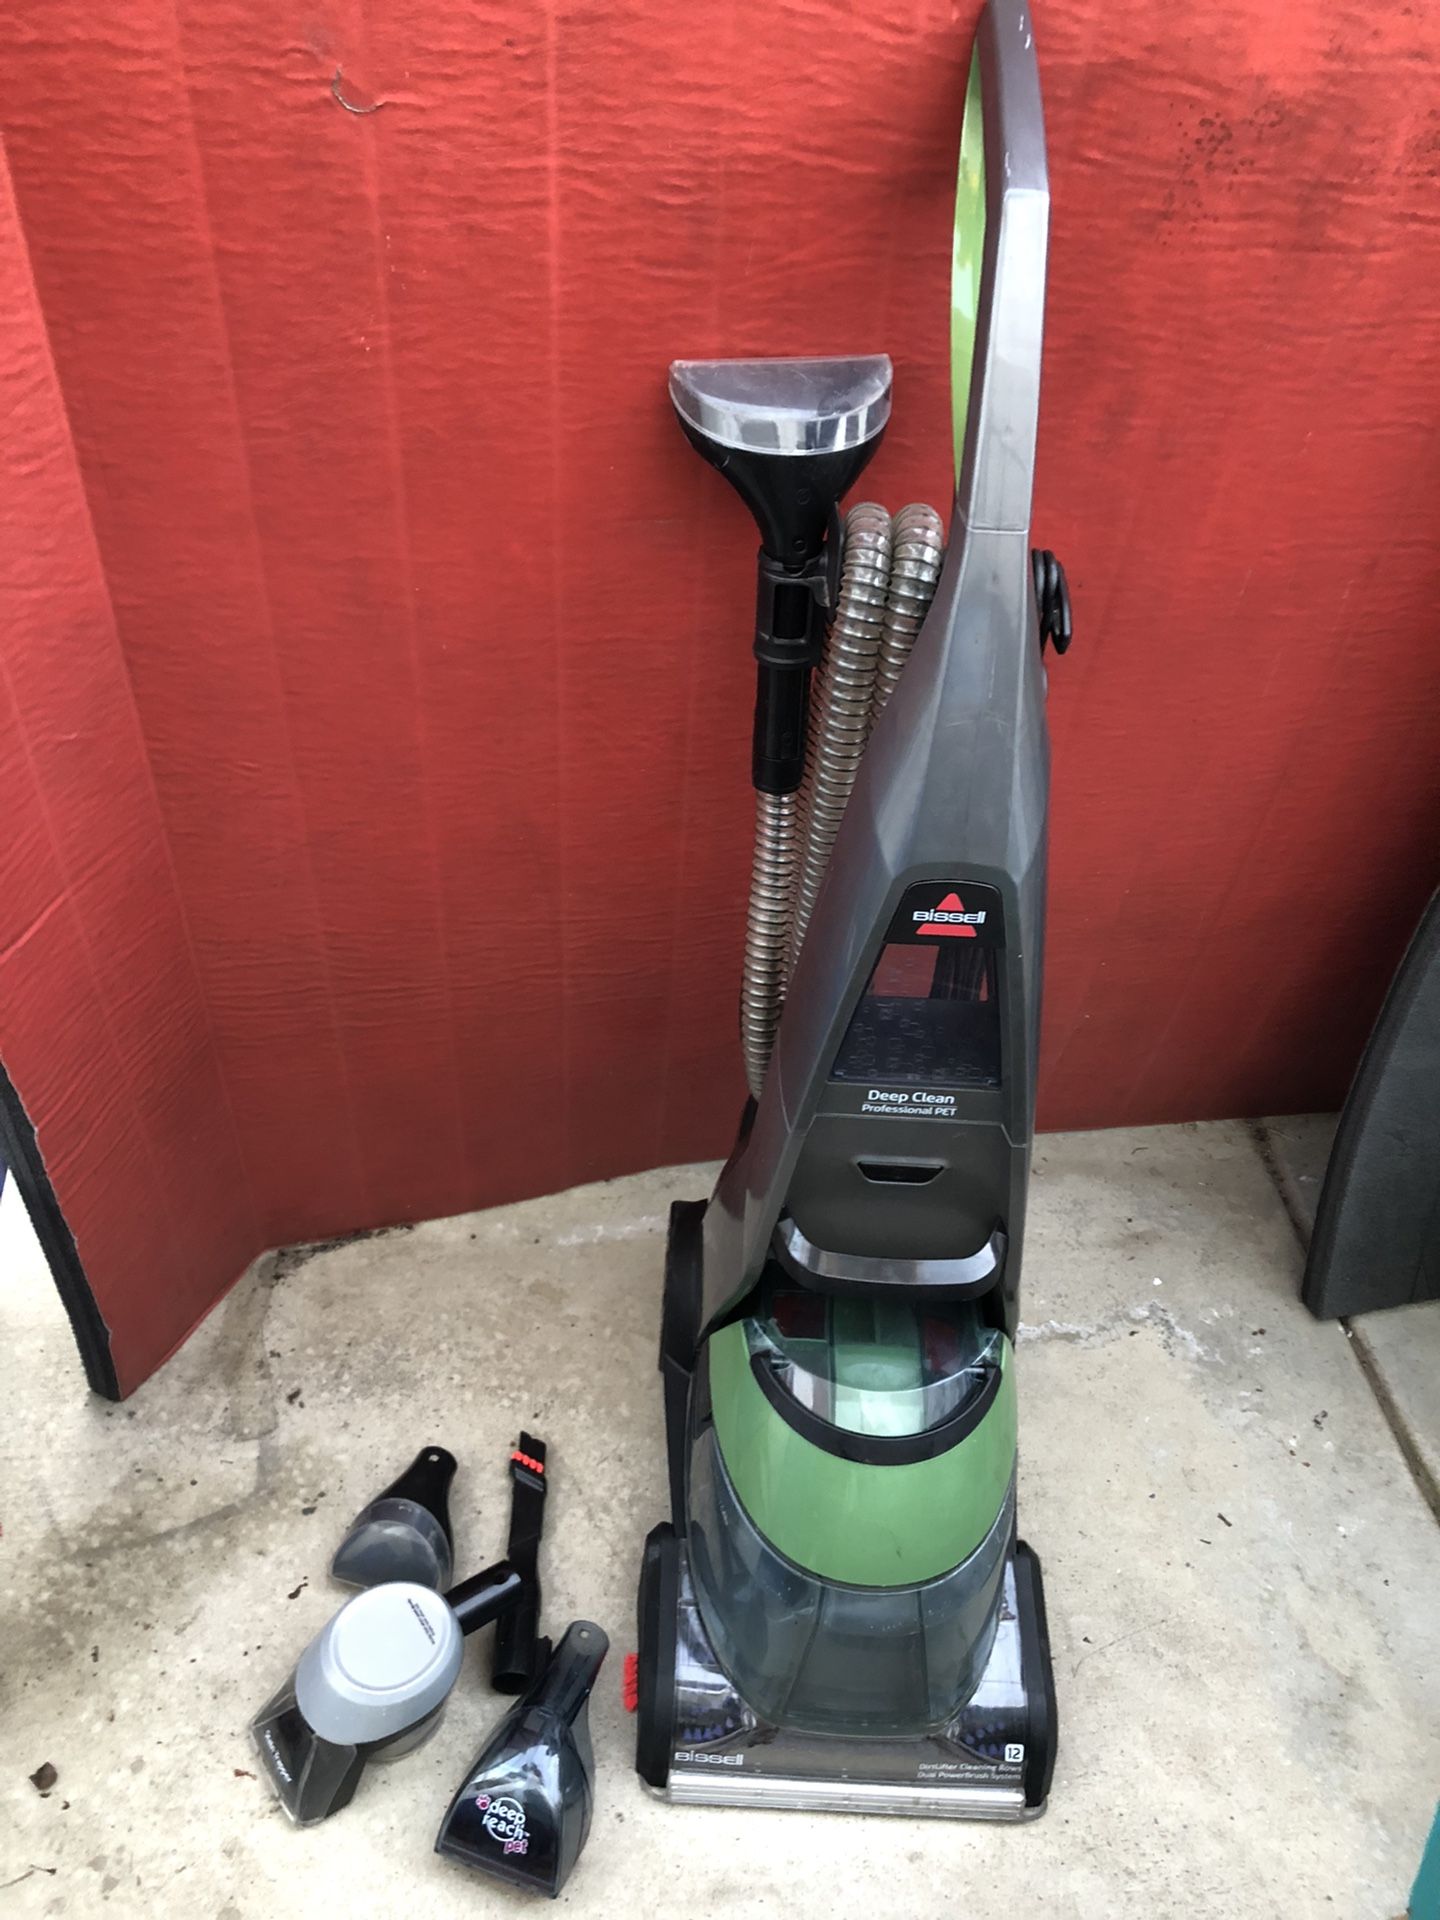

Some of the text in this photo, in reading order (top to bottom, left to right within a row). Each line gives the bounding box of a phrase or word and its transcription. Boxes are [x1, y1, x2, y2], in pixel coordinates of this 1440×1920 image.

[868, 1089, 955, 1104] Deep Clean
[862, 1103, 958, 1116] Professional PET
[1008, 1747, 1021, 1760] 12
[959, 1763, 997, 1772] Cleaning
[917, 1771, 937, 1779] Dual
[489, 1800, 526, 1825] deep
[482, 1814, 525, 1840] reach
[503, 1839, 528, 1855] pet
